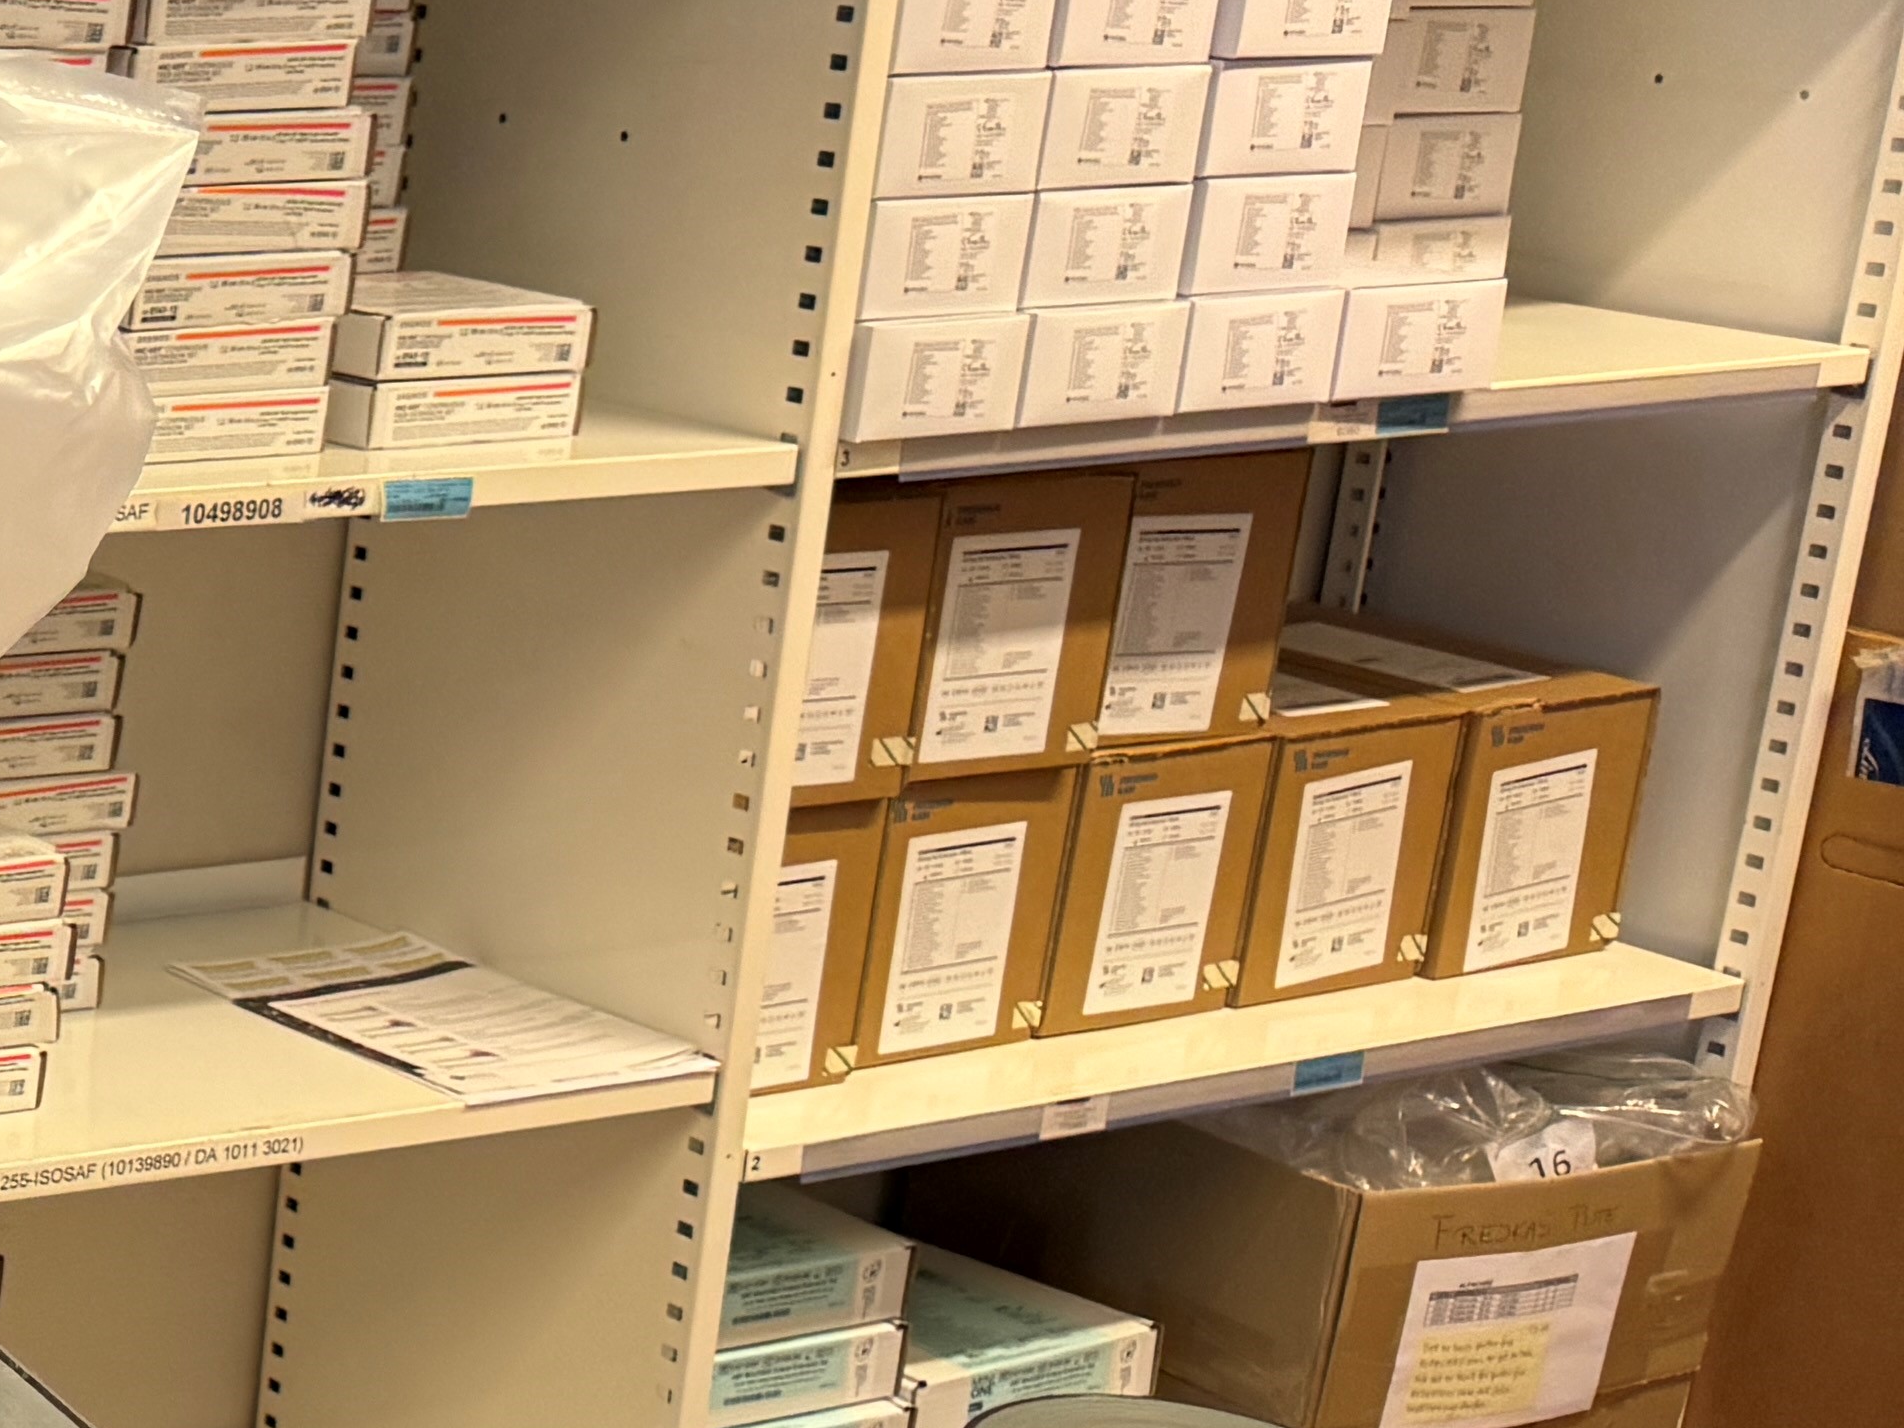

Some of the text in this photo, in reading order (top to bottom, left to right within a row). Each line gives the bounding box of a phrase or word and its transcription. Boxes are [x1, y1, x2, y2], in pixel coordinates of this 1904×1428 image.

[840, 450, 850, 467] 3
[180, 497, 282, 525] 10498908
[101, 1151, 181, 1181] (10139890
[184, 1150, 191, 1168] /
[194, 1148, 217, 1165] DA
[224, 1143, 257, 1161] 1011
[262, 1136, 304, 1158] 3021)
[751, 1156, 760, 1171] 2
